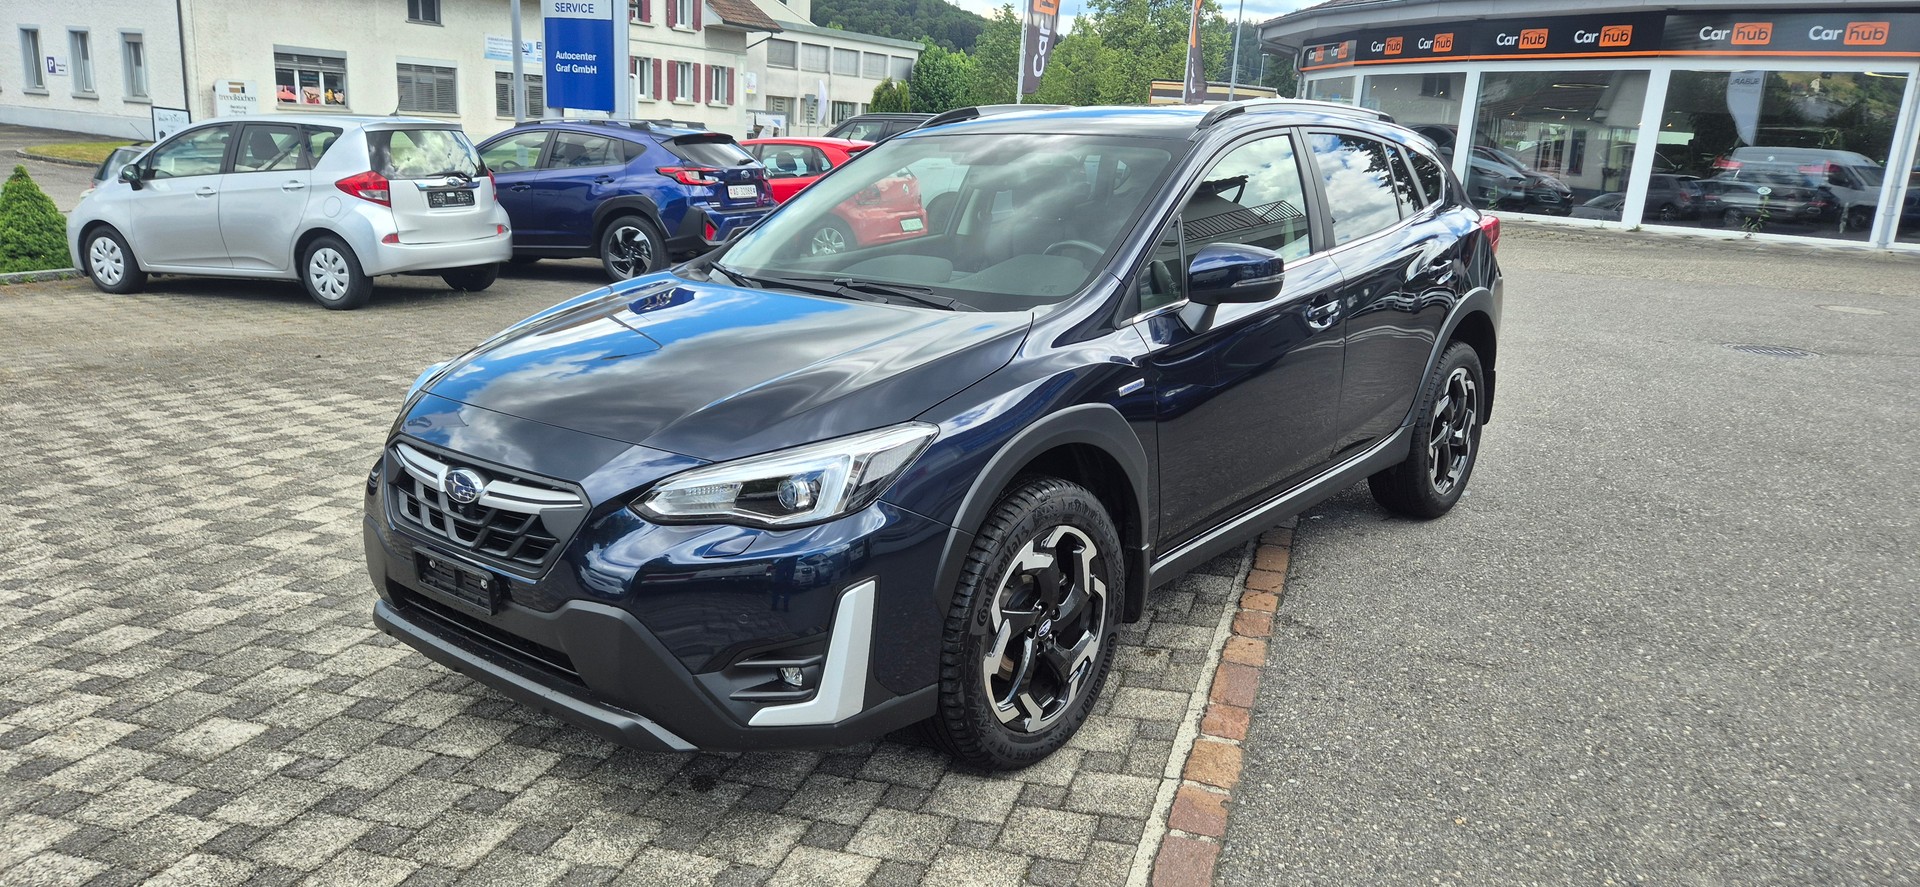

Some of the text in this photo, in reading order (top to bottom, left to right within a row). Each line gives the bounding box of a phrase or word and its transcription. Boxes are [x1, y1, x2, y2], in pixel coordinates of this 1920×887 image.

[555, 2, 594, 13] SERVICE
[1496, 31, 1545, 46] Car hub
[1574, 28, 1629, 44] Car hub
[1699, 25, 1768, 41] Car hub
[1808, 25, 1885, 41] Car hub
[1033, 19, 1050, 77] Car
[1371, 39, 1401, 52] Car hub
[1418, 36, 1451, 49] Car hub
[555, 50, 597, 61] Autocenter
[48, 59, 54, 71] P
[555, 63, 597, 74] Graf GmbH
